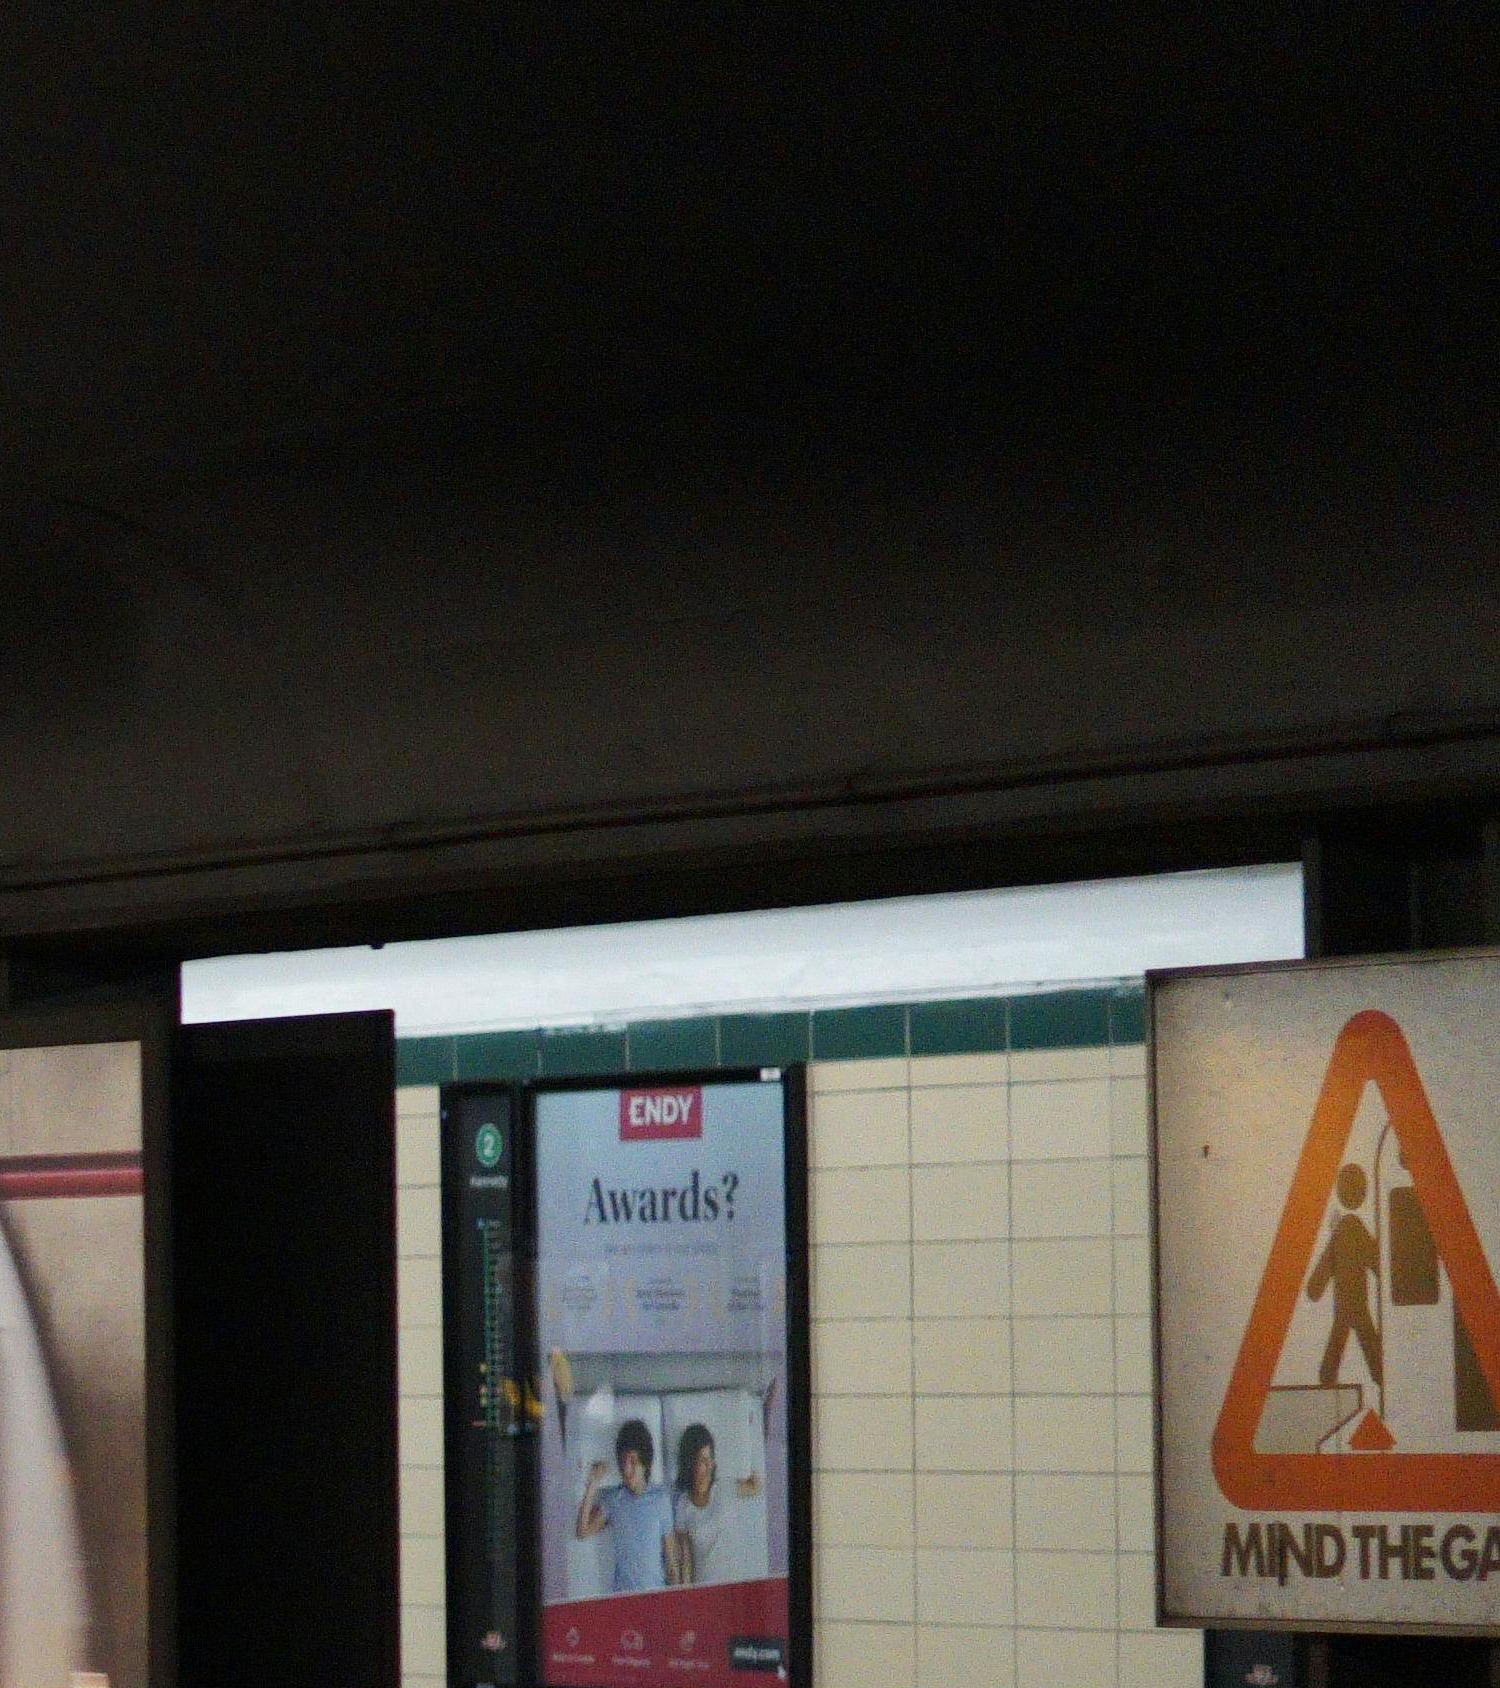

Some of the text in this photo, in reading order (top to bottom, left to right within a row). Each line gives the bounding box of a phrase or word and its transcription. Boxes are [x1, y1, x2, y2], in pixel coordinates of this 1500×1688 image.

[628, 1093, 694, 1126] ENDY
[583, 1169, 740, 1226] Awards?
[1220, 1521, 1347, 1580] MIND
[1351, 1523, 1437, 1581] THE
